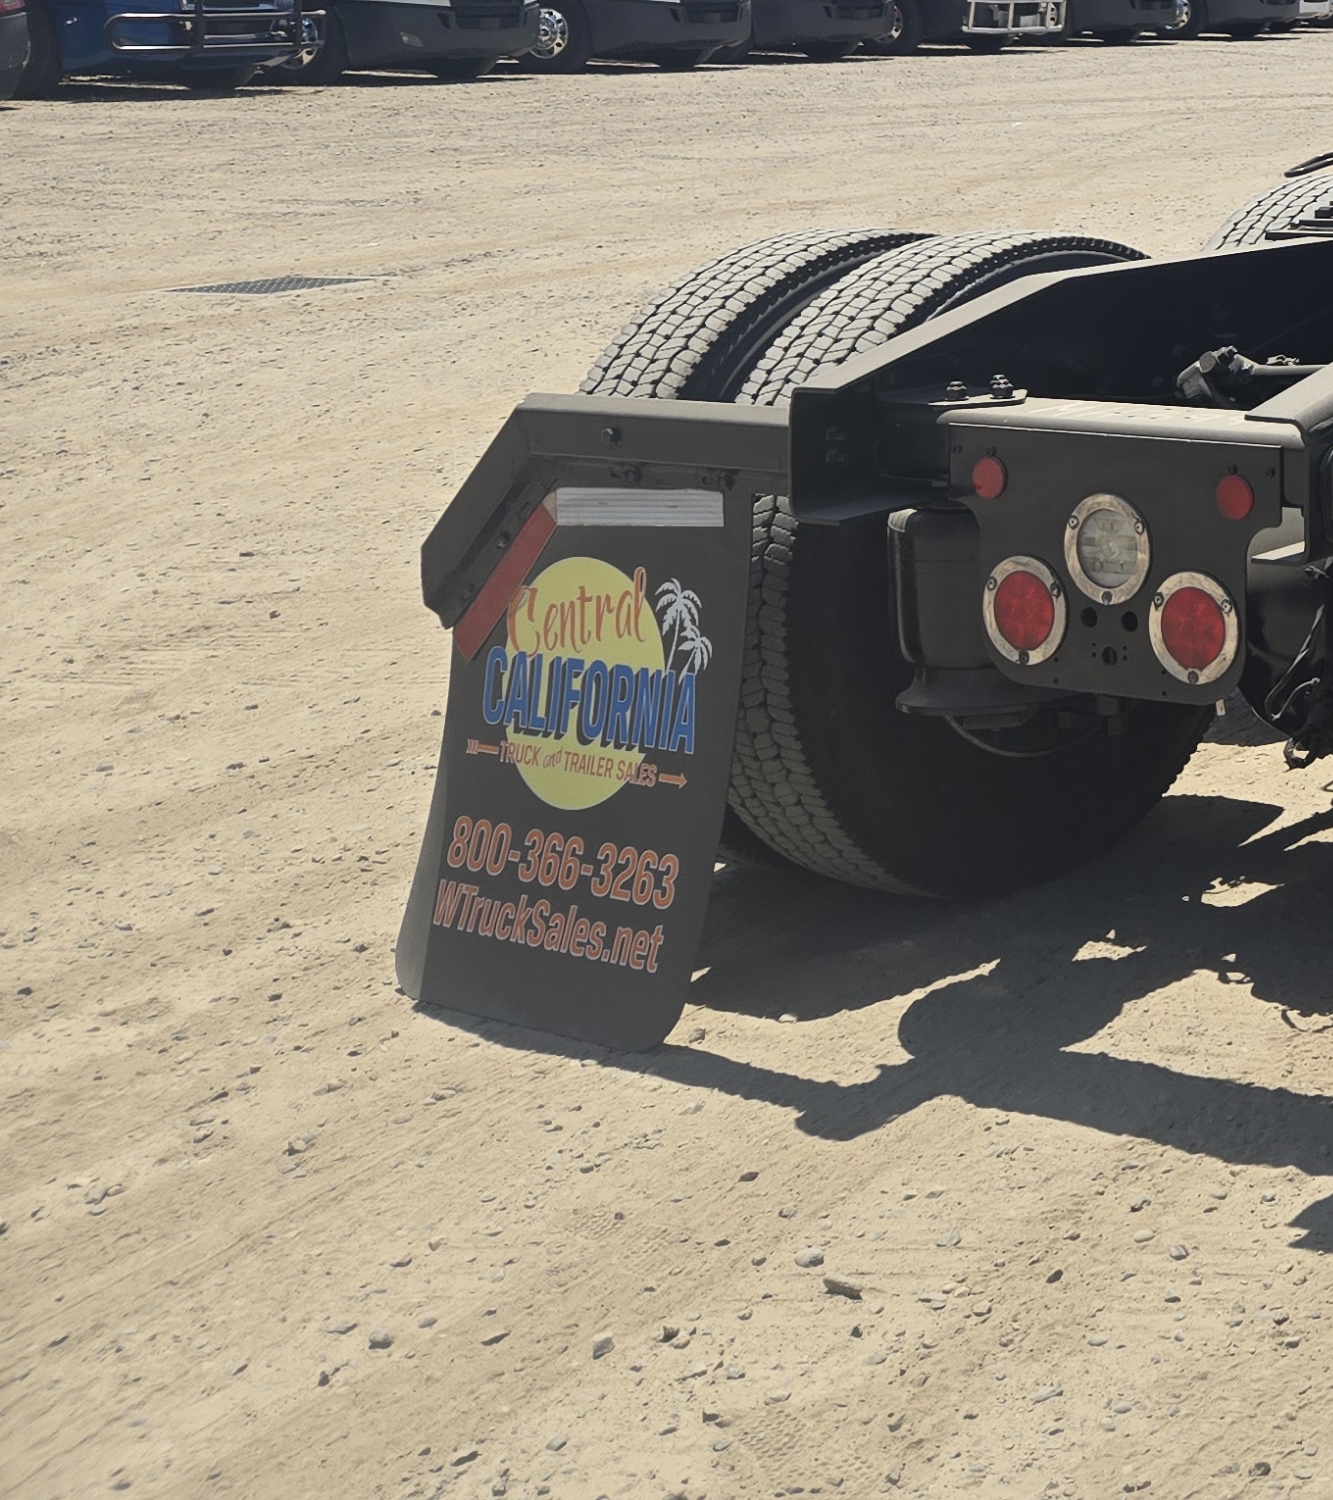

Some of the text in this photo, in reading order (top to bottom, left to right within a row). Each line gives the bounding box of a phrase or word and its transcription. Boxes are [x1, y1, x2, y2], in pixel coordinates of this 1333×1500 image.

[507, 566, 646, 658] Central
[482, 645, 696, 755] CALIFORNIA
[500, 740, 658, 787] TRUCK and TRAILER SALES
[446, 815, 680, 910] 800-366-3263
[432, 878, 665, 973] WTruckSales.net
